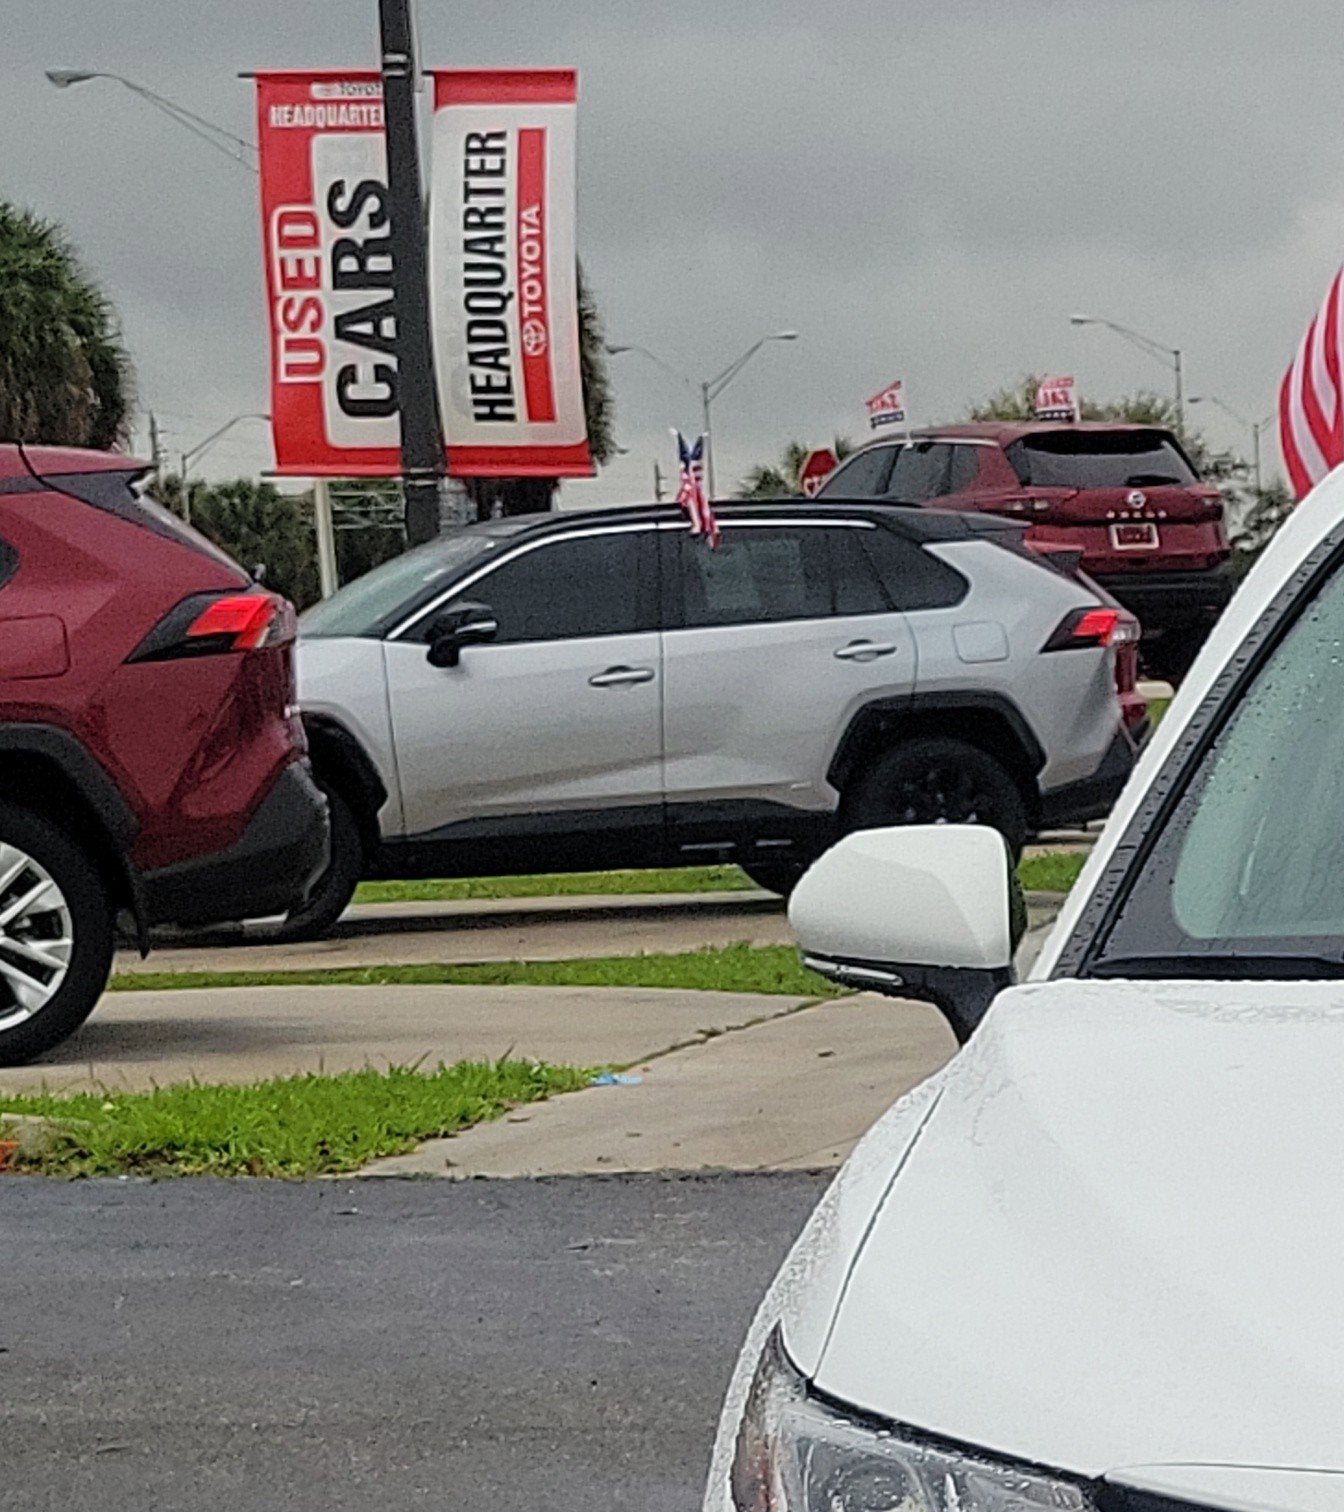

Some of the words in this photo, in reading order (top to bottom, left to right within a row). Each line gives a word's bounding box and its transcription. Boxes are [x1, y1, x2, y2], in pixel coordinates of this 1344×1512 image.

[270, 104, 384, 128] HEADQUARTE
[276, 208, 326, 380] USED
[328, 179, 400, 419] CARS
[463, 131, 516, 424] HEADQUARTER
[518, 204, 545, 318] TOYOTA
